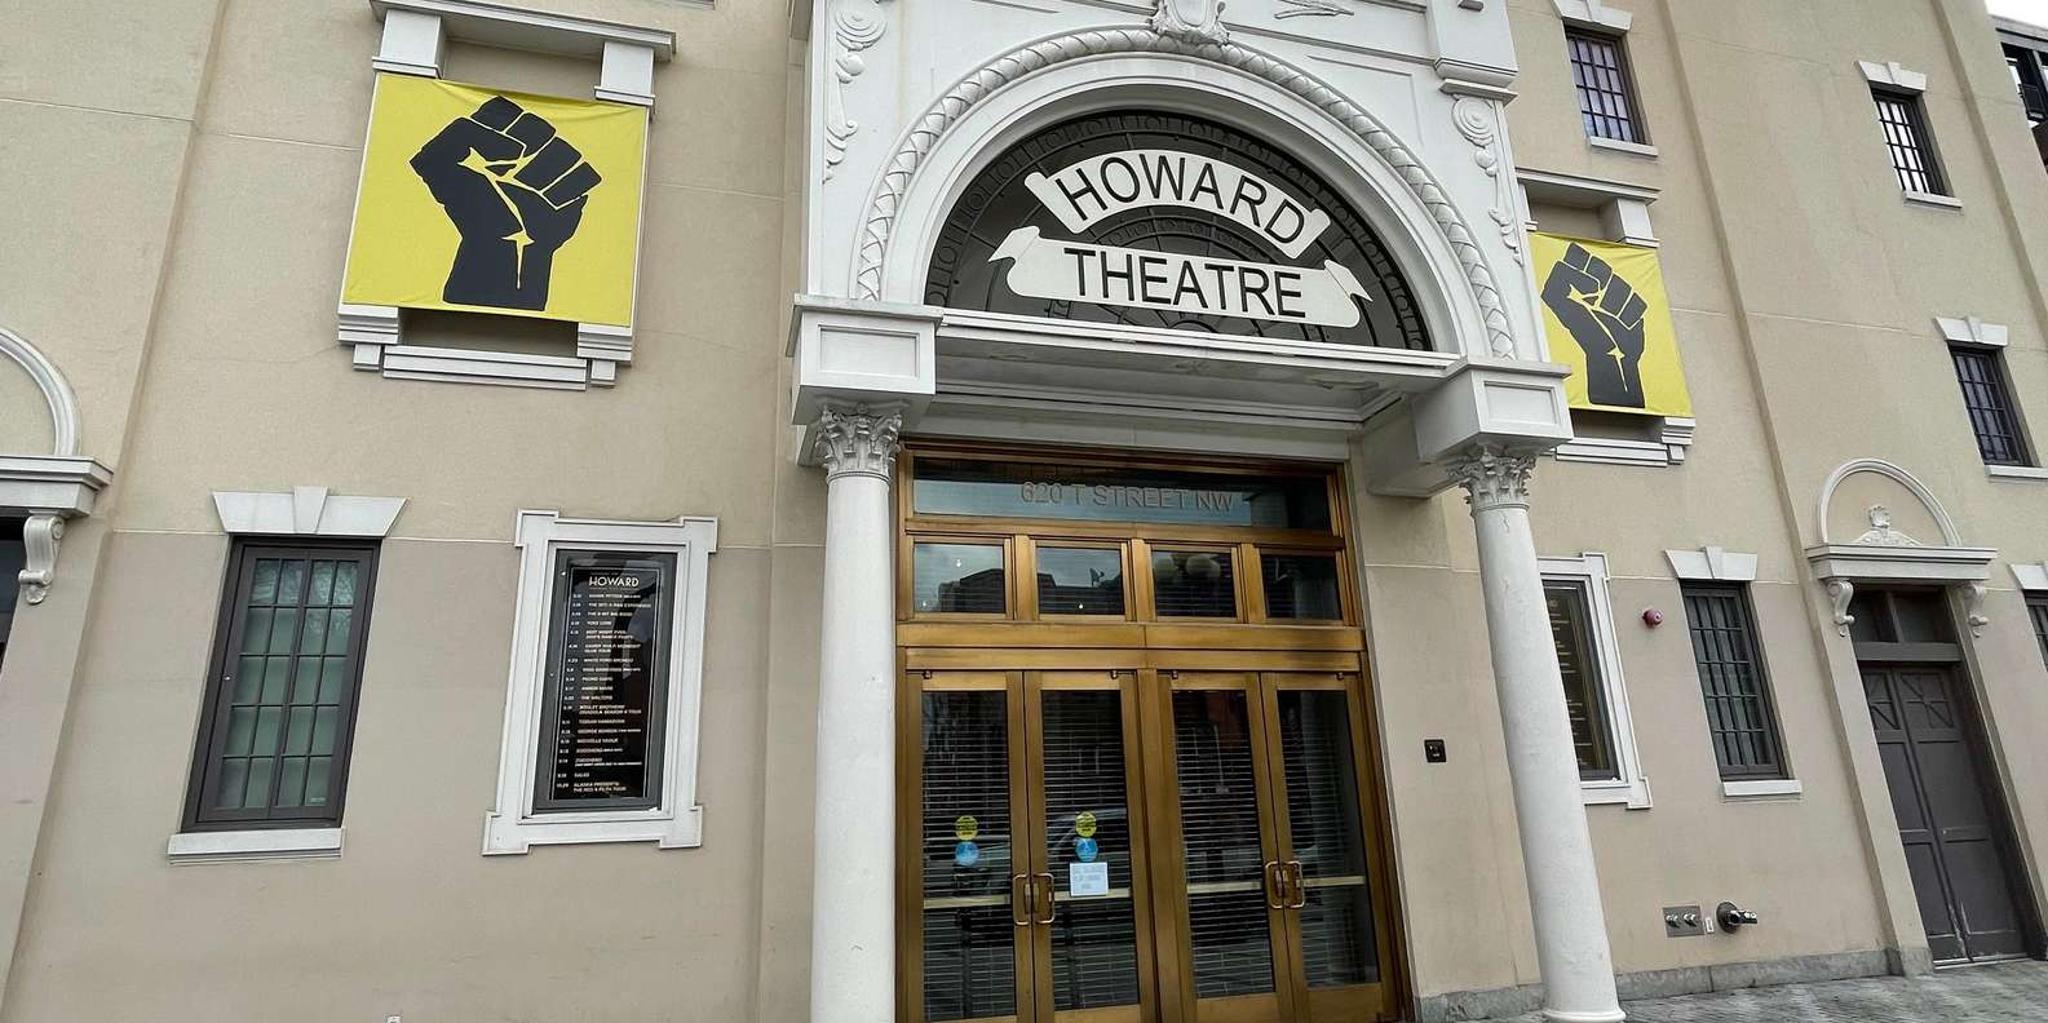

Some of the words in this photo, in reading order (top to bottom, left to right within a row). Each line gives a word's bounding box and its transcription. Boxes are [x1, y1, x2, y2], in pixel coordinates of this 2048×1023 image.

[1054, 153, 1307, 245] HOWARD
[1063, 247, 1307, 319] THEATRE
[1021, 481, 1063, 505] 620
[1071, 483, 1087, 505] T
[1093, 485, 1189, 511] STREET
[1196, 490, 1234, 512] NW
[588, 576, 640, 587] HOWARD
